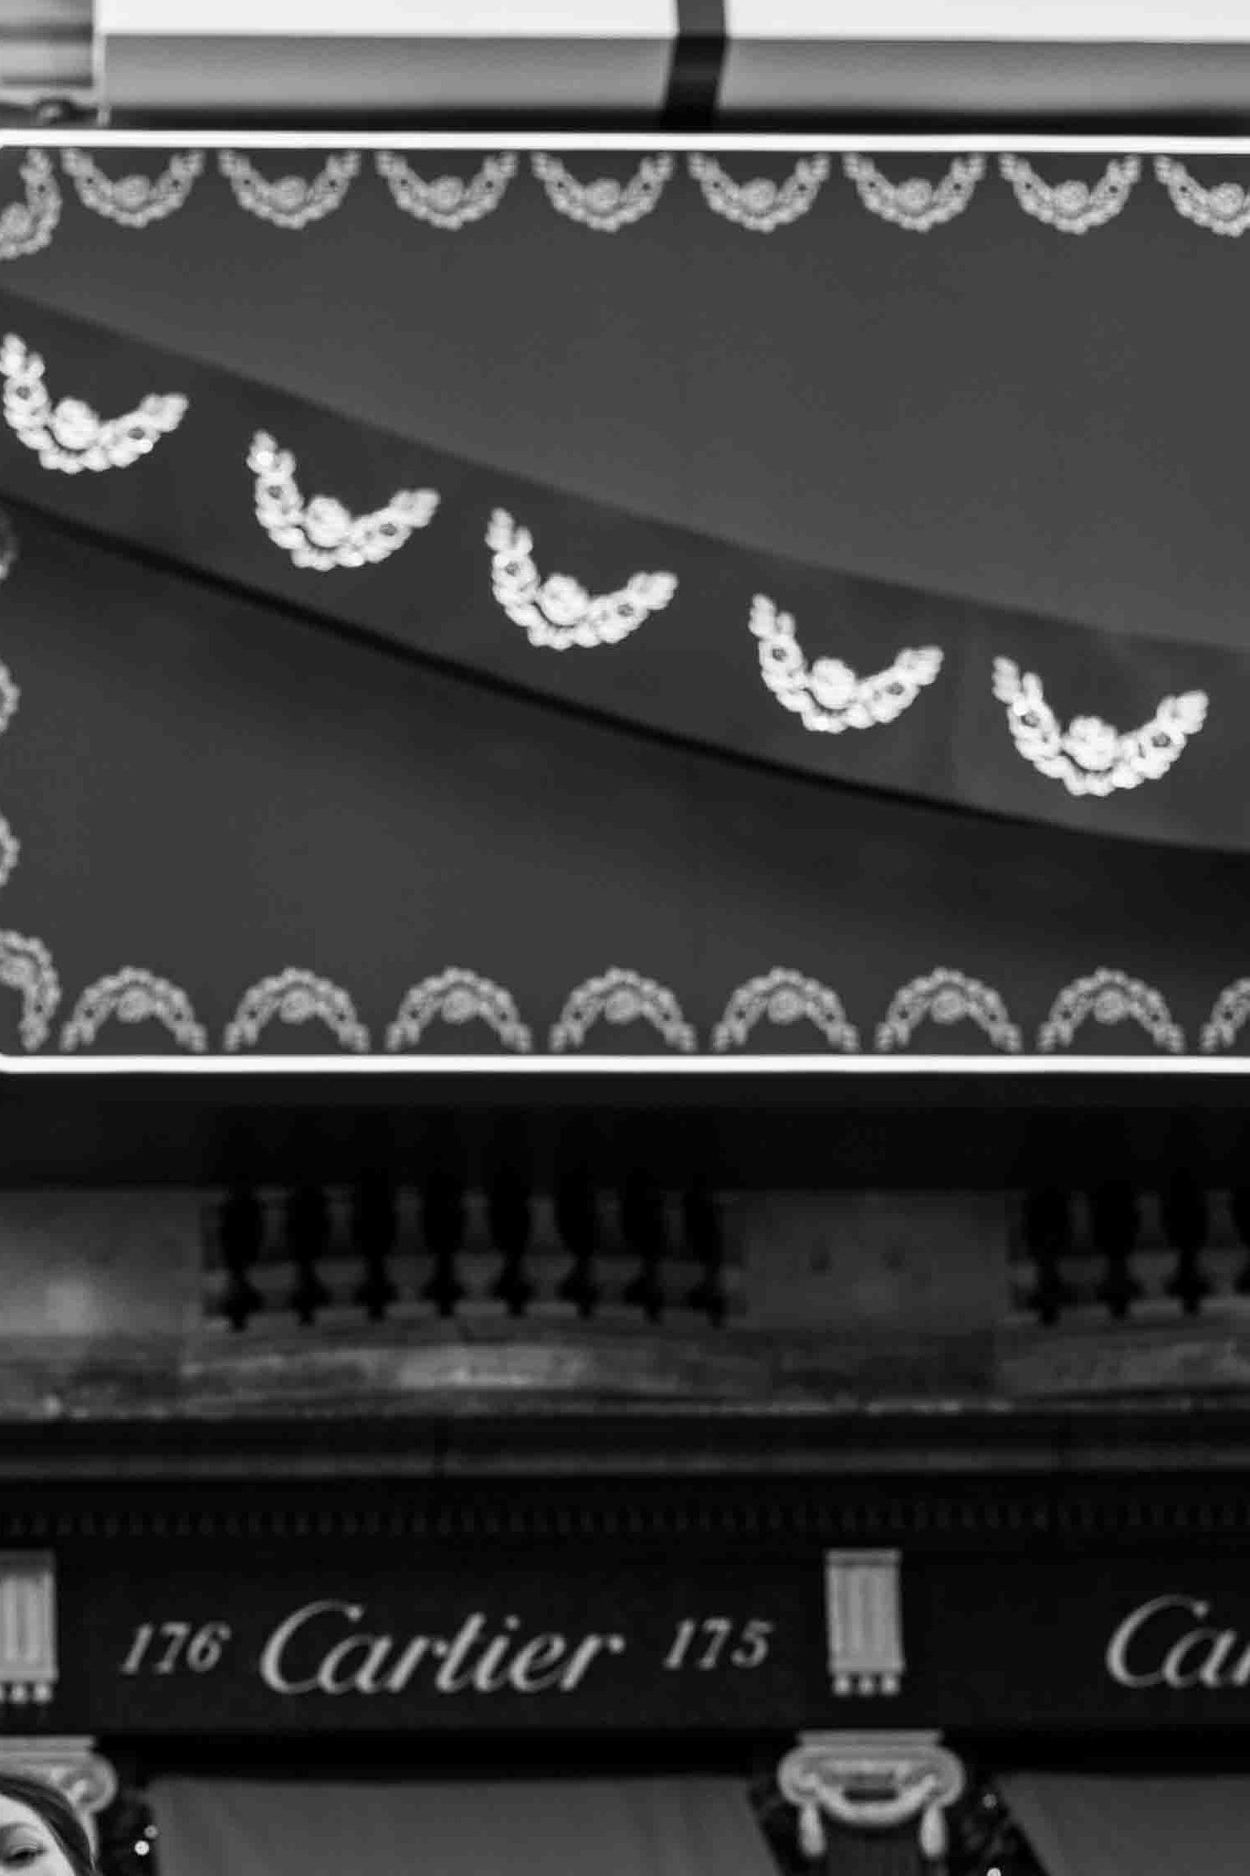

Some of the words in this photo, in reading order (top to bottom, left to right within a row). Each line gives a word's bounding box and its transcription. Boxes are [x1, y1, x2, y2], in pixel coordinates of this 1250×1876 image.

[122, 1622, 231, 1674] 176
[259, 1601, 625, 1694] Cartier
[664, 1618, 772, 1669] 175
